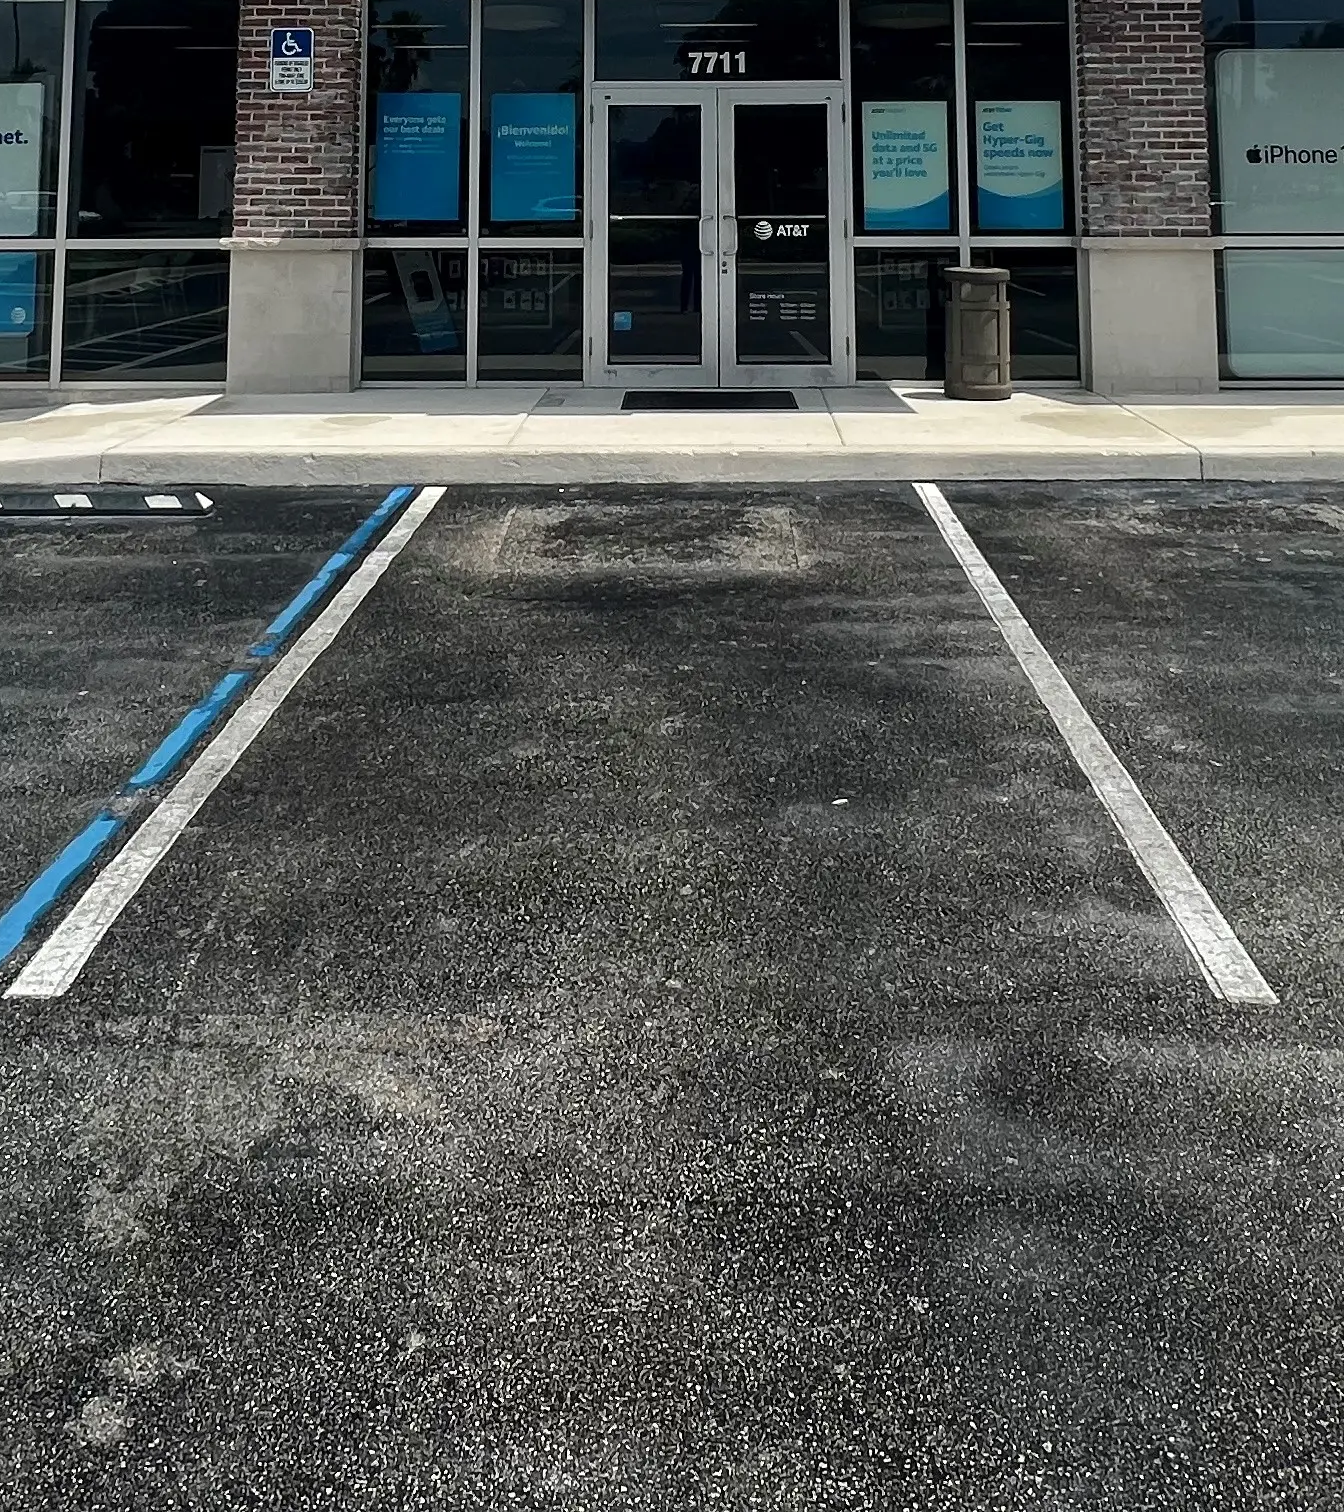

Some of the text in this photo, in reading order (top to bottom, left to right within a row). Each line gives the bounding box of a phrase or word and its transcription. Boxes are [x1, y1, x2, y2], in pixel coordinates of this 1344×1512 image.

[688, 51, 746, 74] 7711
[497, 124, 569, 138] ¡Bienvenido!
[982, 121, 1004, 132] Get
[871, 130, 926, 140] Unlimited
[982, 134, 1045, 147] Hyper-Gig
[871, 142, 938, 153] data and 5G
[983, 147, 1054, 160] speeds now
[1264, 144, 1338, 164] iPhone
[872, 155, 923, 166] at a price
[904, 167, 928, 178] love
[776, 224, 810, 237] AT&T
